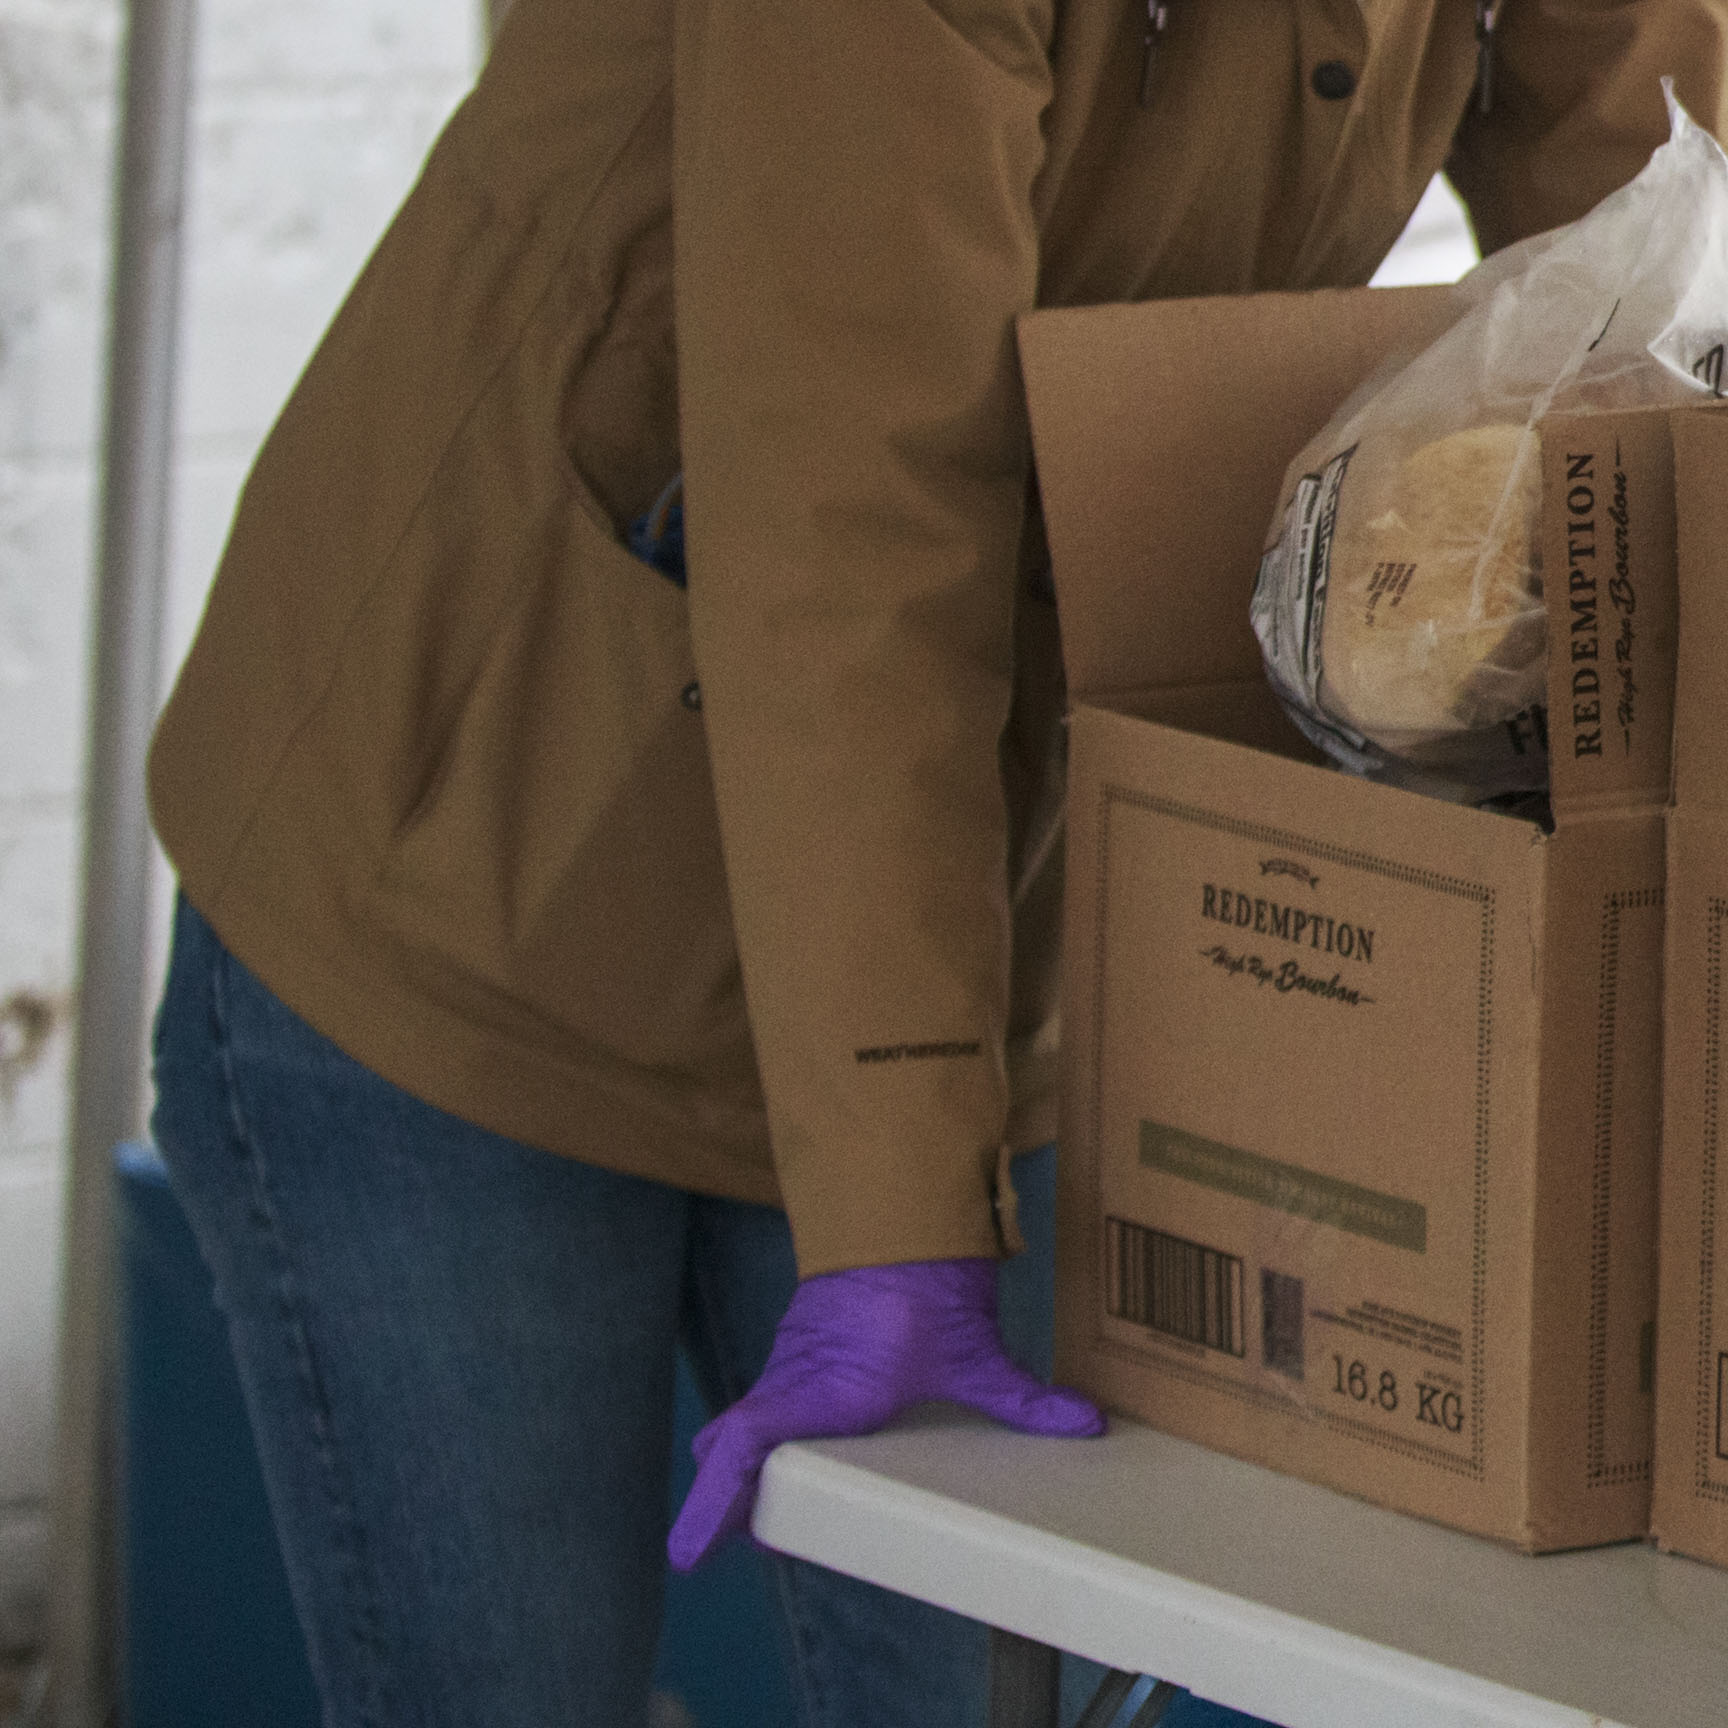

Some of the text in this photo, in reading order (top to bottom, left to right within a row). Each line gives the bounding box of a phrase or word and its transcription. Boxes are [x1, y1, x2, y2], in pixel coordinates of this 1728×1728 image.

[1608, 472, 1635, 615] Bourbon
[1567, 453, 1602, 759] REDEMPTION
[1203, 883, 1375, 964] REDEMPTION
[1274, 960, 1360, 1005] Bourbon
[1332, 1354, 1465, 1434] 16.8 KG
